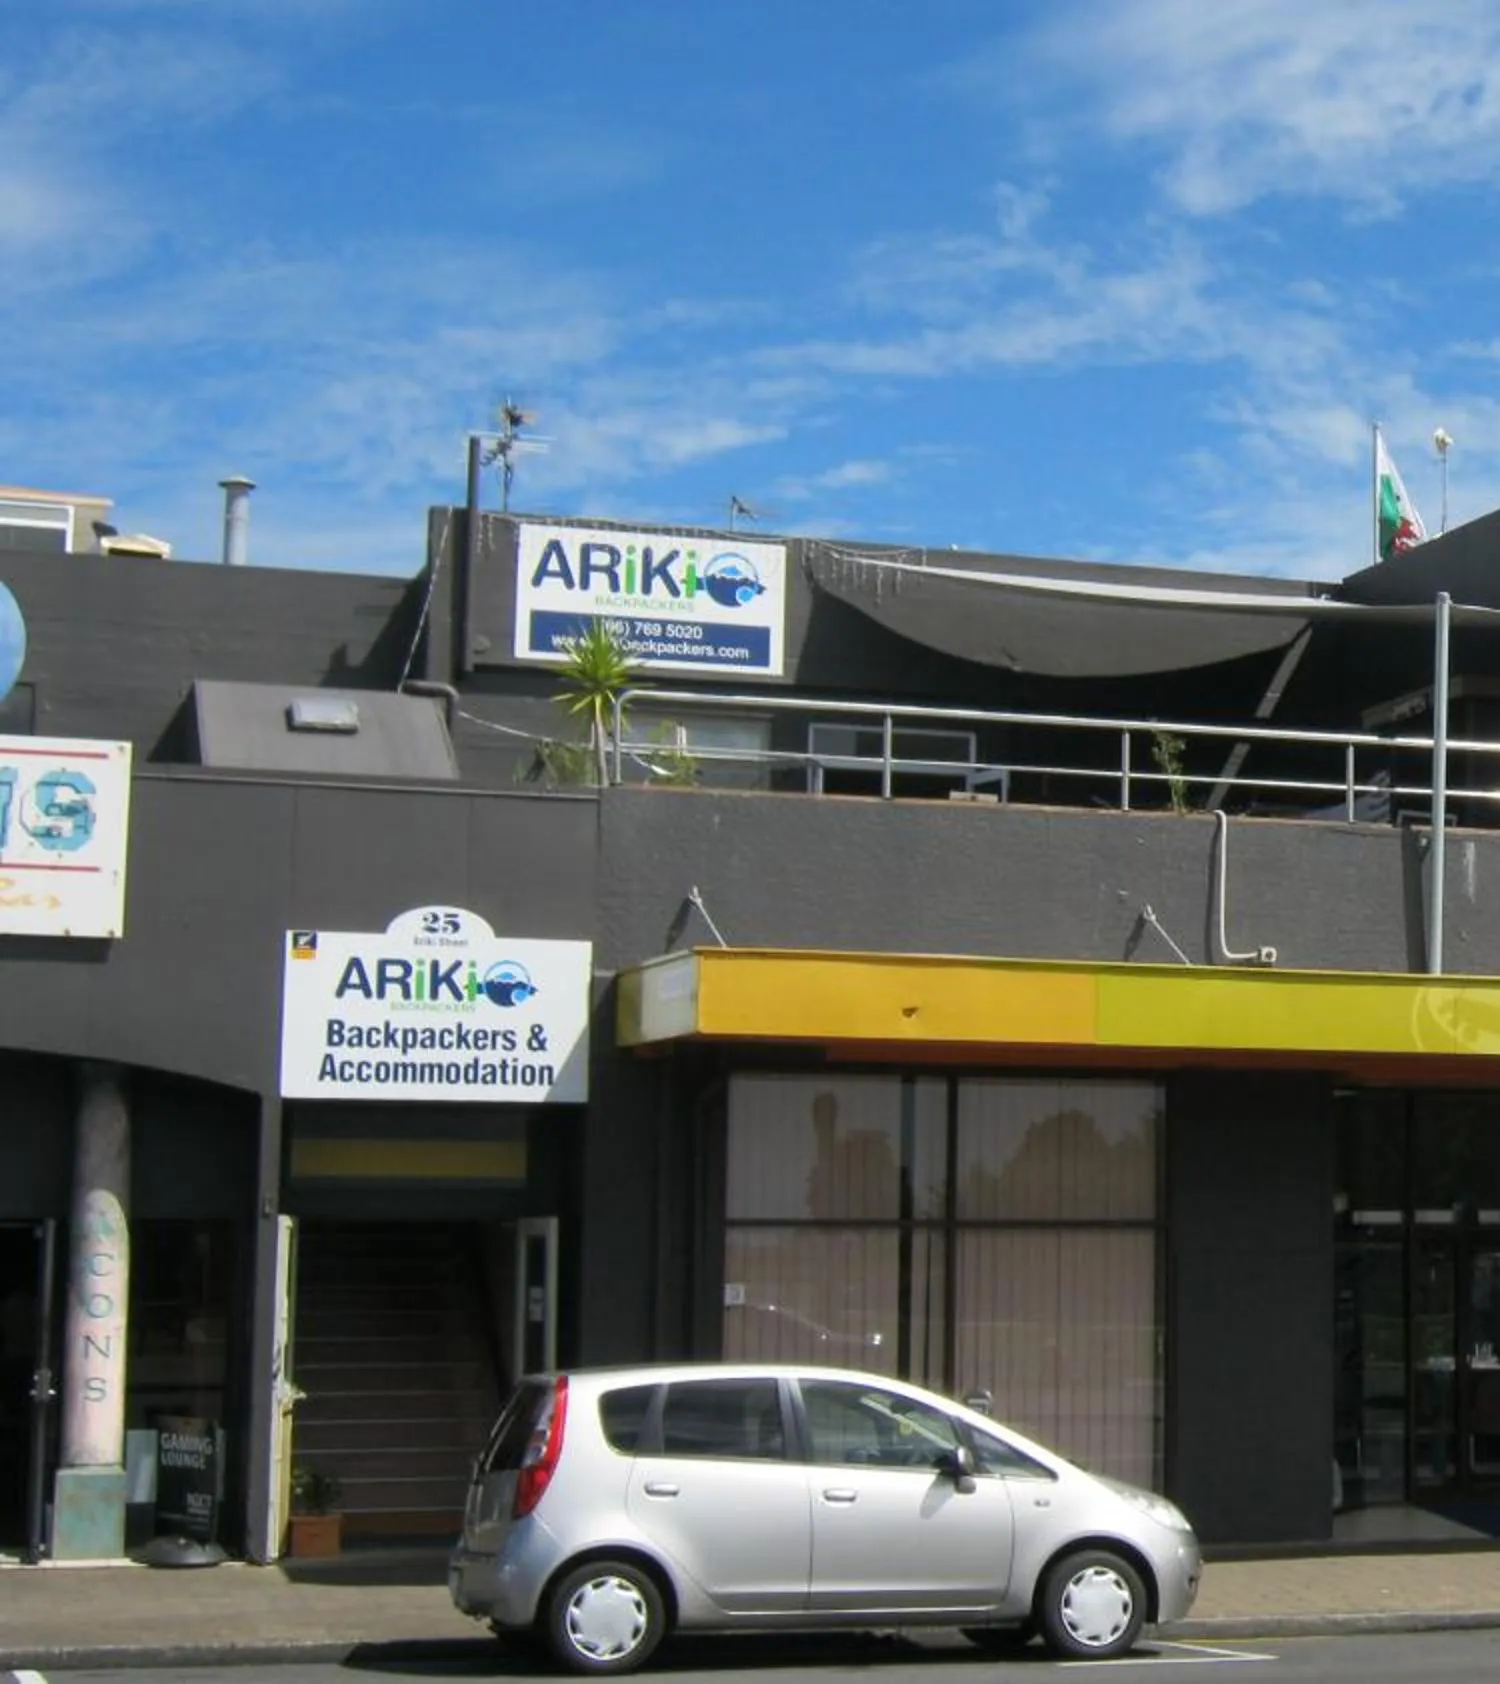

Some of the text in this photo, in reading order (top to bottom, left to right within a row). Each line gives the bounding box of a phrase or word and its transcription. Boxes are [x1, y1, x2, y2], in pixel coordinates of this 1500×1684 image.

[634, 621, 661, 638] 769
[666, 622, 702, 640] 5020
[422, 911, 461, 934] 25
[326, 1019, 549, 1056] Backpackers &
[318, 1053, 555, 1086] Accommodation
